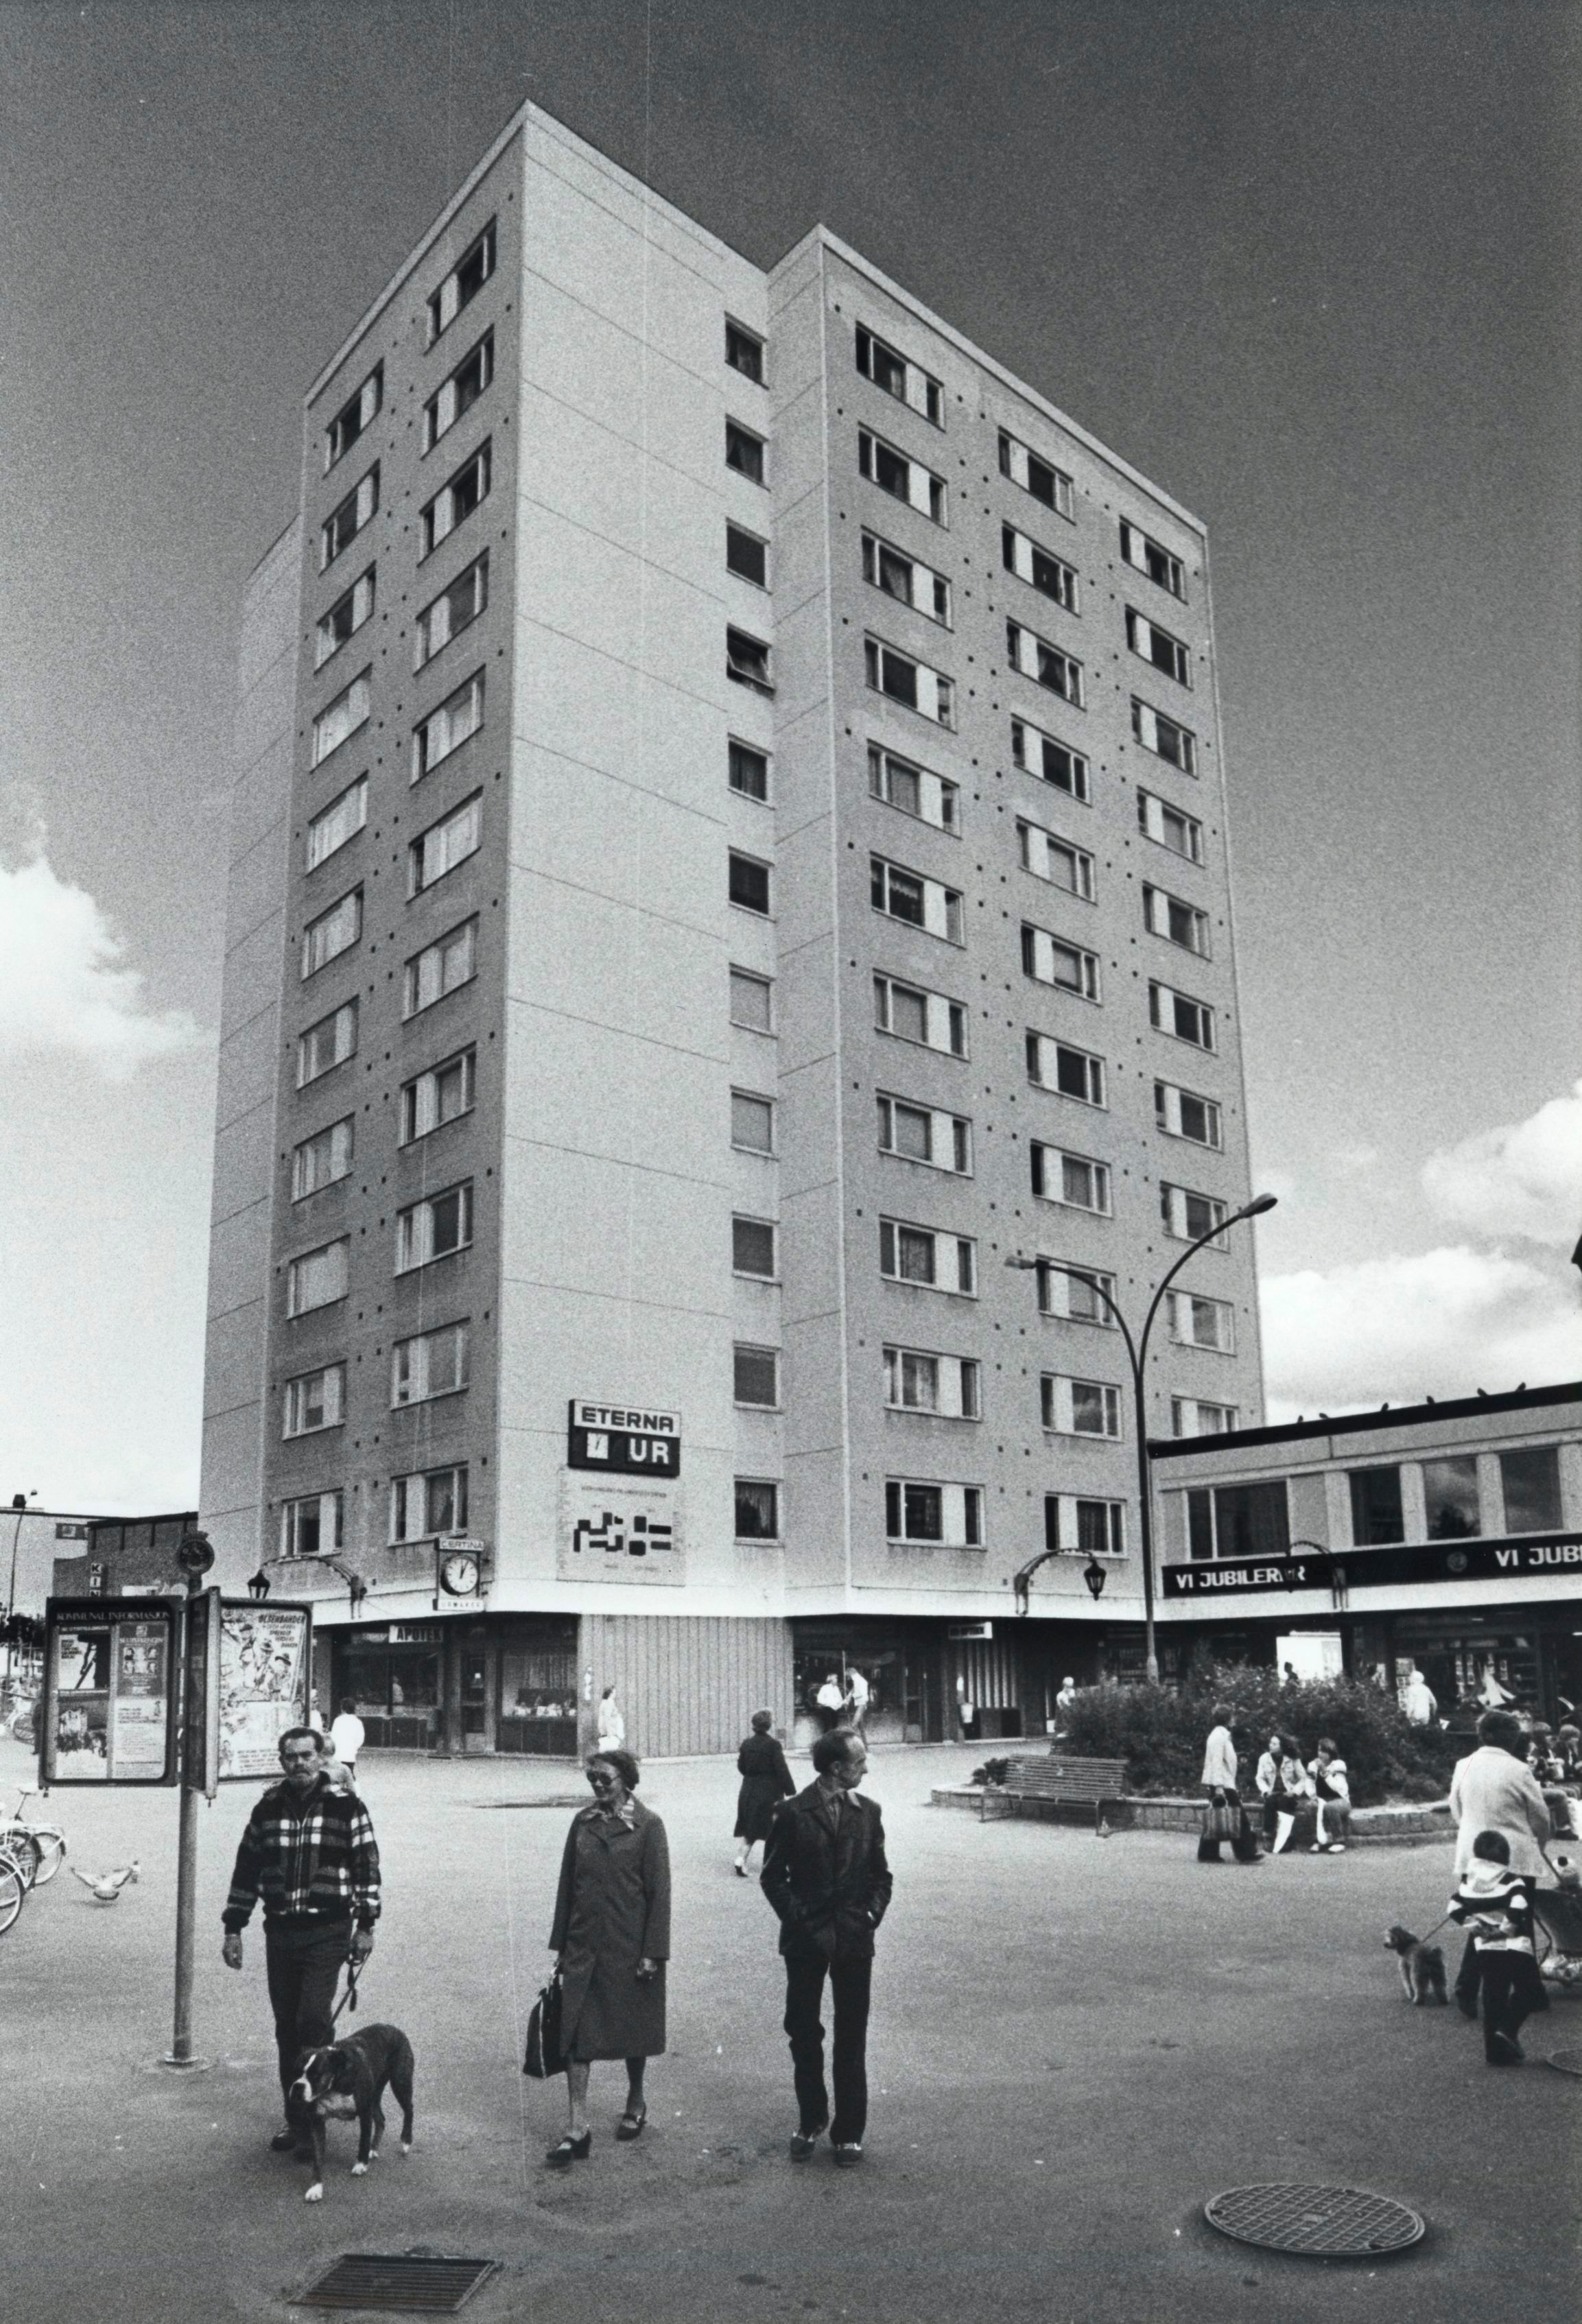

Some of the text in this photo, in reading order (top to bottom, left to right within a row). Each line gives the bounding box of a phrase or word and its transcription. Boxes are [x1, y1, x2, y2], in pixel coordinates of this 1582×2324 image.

[582, 1407, 674, 1432] ETERNA
[630, 1438, 669, 1464] UR
[1495, 1550, 1519, 1567] VI
[1176, 1574, 1193, 1589] VI
[56, 1611, 169, 1620] KOMMUNAL INFORMASJON
[397, 1626, 442, 1641] APOTEK
